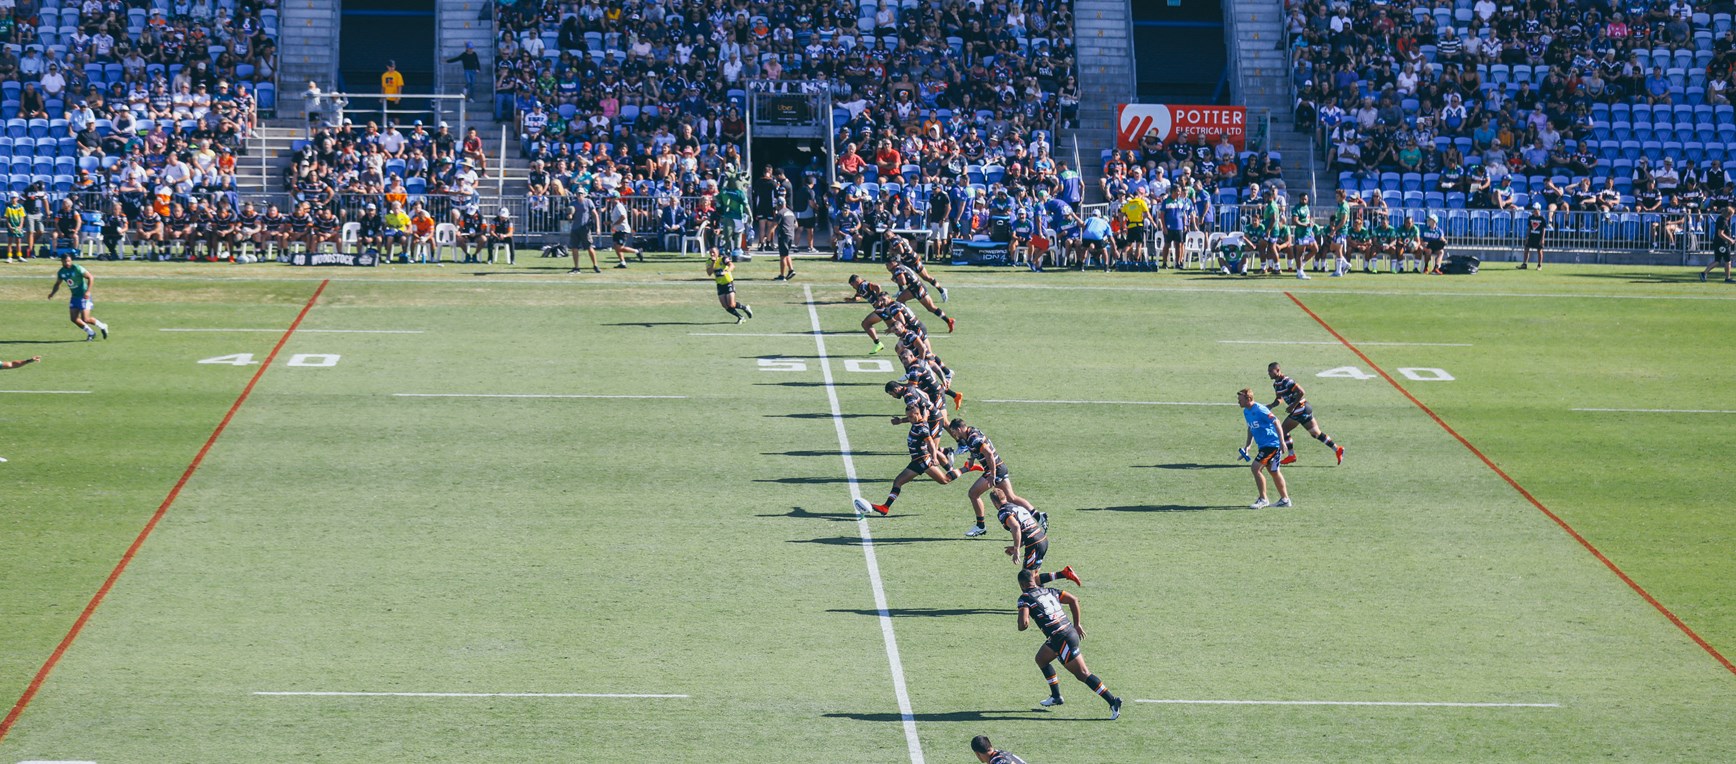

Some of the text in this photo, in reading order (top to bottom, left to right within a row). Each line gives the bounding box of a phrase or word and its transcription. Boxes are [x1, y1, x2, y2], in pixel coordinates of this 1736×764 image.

[1176, 110, 1243, 125] POTTER
[1226, 127, 1242, 136] LTD
[293, 254, 306, 266] 40
[311, 253, 356, 266] WOODSTOCK
